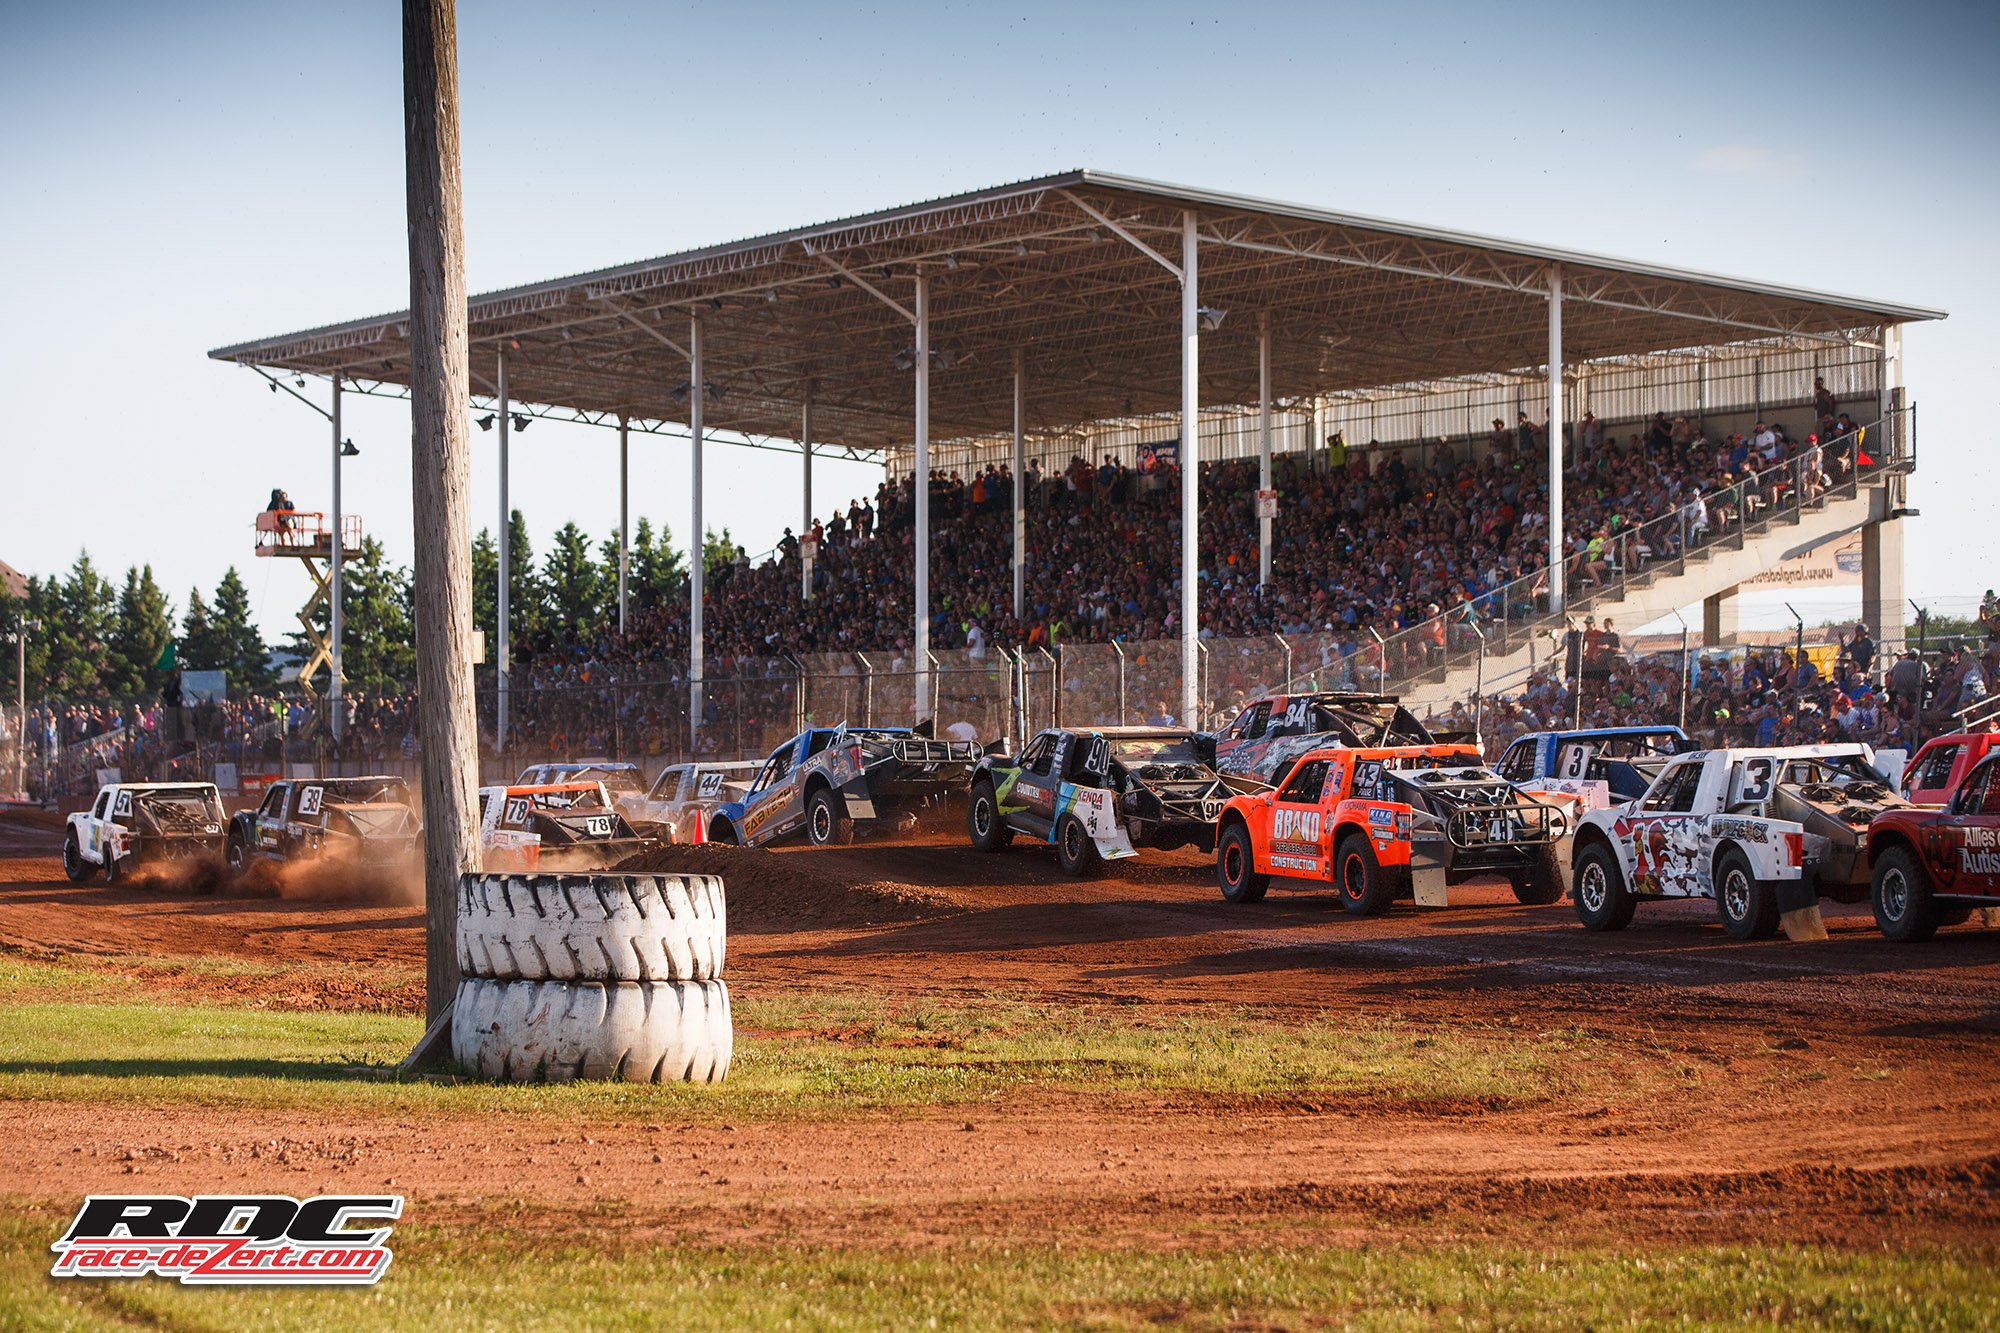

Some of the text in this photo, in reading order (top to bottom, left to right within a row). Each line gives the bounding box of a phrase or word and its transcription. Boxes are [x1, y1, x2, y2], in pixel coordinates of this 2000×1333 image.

[1284, 703, 1307, 728] 84
[803, 755, 822, 771] ULTRA
[1087, 737, 1110, 774] 90
[1568, 746, 1584, 778] 3
[702, 775, 719, 791] 44
[1353, 763, 1380, 788] 43
[1743, 758, 1772, 800] 3
[303, 788, 320, 812] 38
[1077, 789, 1104, 804] KENDA
[507, 798, 529, 822] 78
[1370, 809, 1392, 819] KING
[588, 818, 609, 832] 78
[1274, 809, 1321, 843] BRAND
[1962, 826, 1996, 848] Allies
[1270, 855, 1317, 872] CONSTRUCTION
